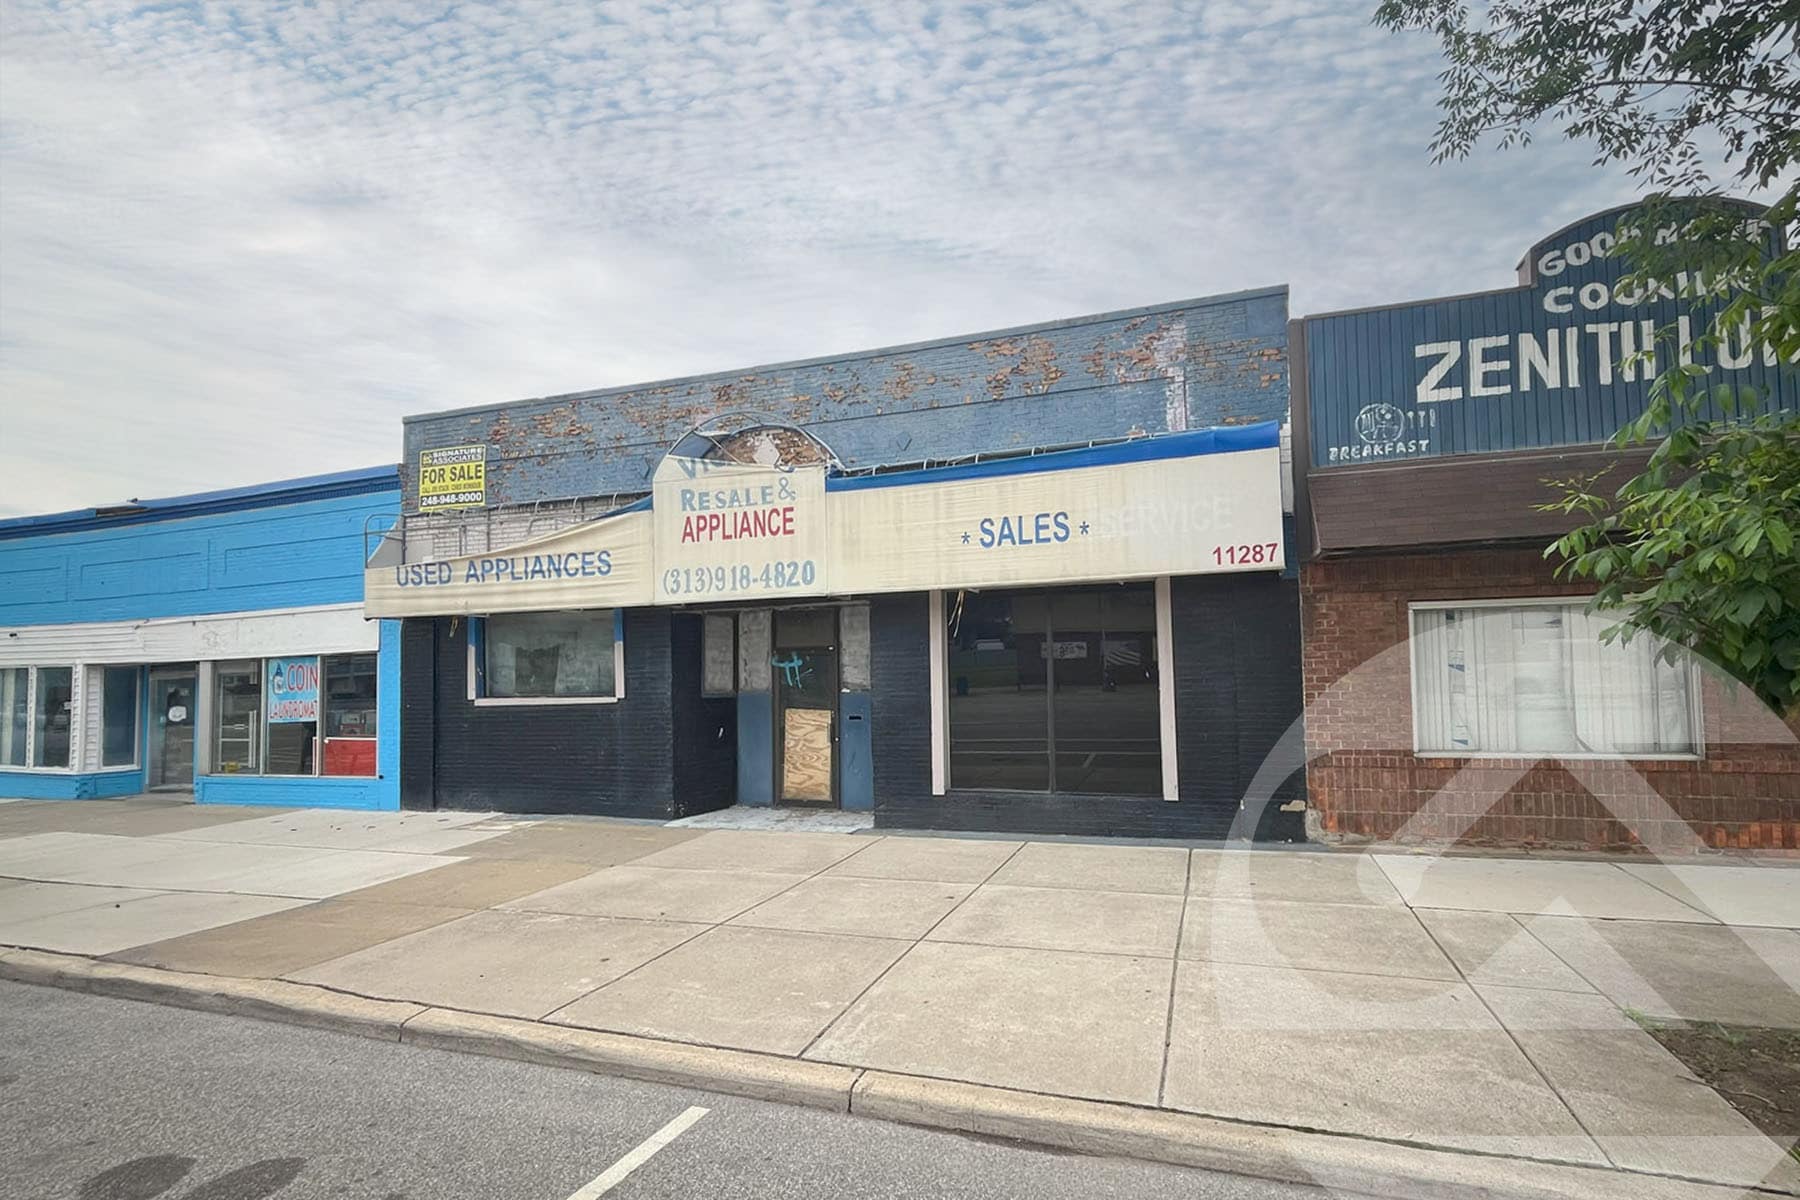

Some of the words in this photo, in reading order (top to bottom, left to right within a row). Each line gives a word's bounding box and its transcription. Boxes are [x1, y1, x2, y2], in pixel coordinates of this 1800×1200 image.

[1414, 319, 1656, 404] ZENITH
[432, 454, 483, 465] ASSOCIATES
[433, 447, 483, 458] SIGNATURE
[1329, 440, 1429, 461] BREAKFAST
[422, 468, 446, 485] FOR
[449, 464, 483, 482] SALE
[680, 485, 775, 512] RESALE
[682, 507, 795, 543] APPLIANCE
[979, 511, 1071, 548] SALES
[1213, 543, 1278, 565] 11287
[396, 561, 452, 587] USED
[465, 550, 612, 584] APPLIANCES
[663, 560, 816, 595] (313)918-4820
[287, 663, 318, 692] COIN
